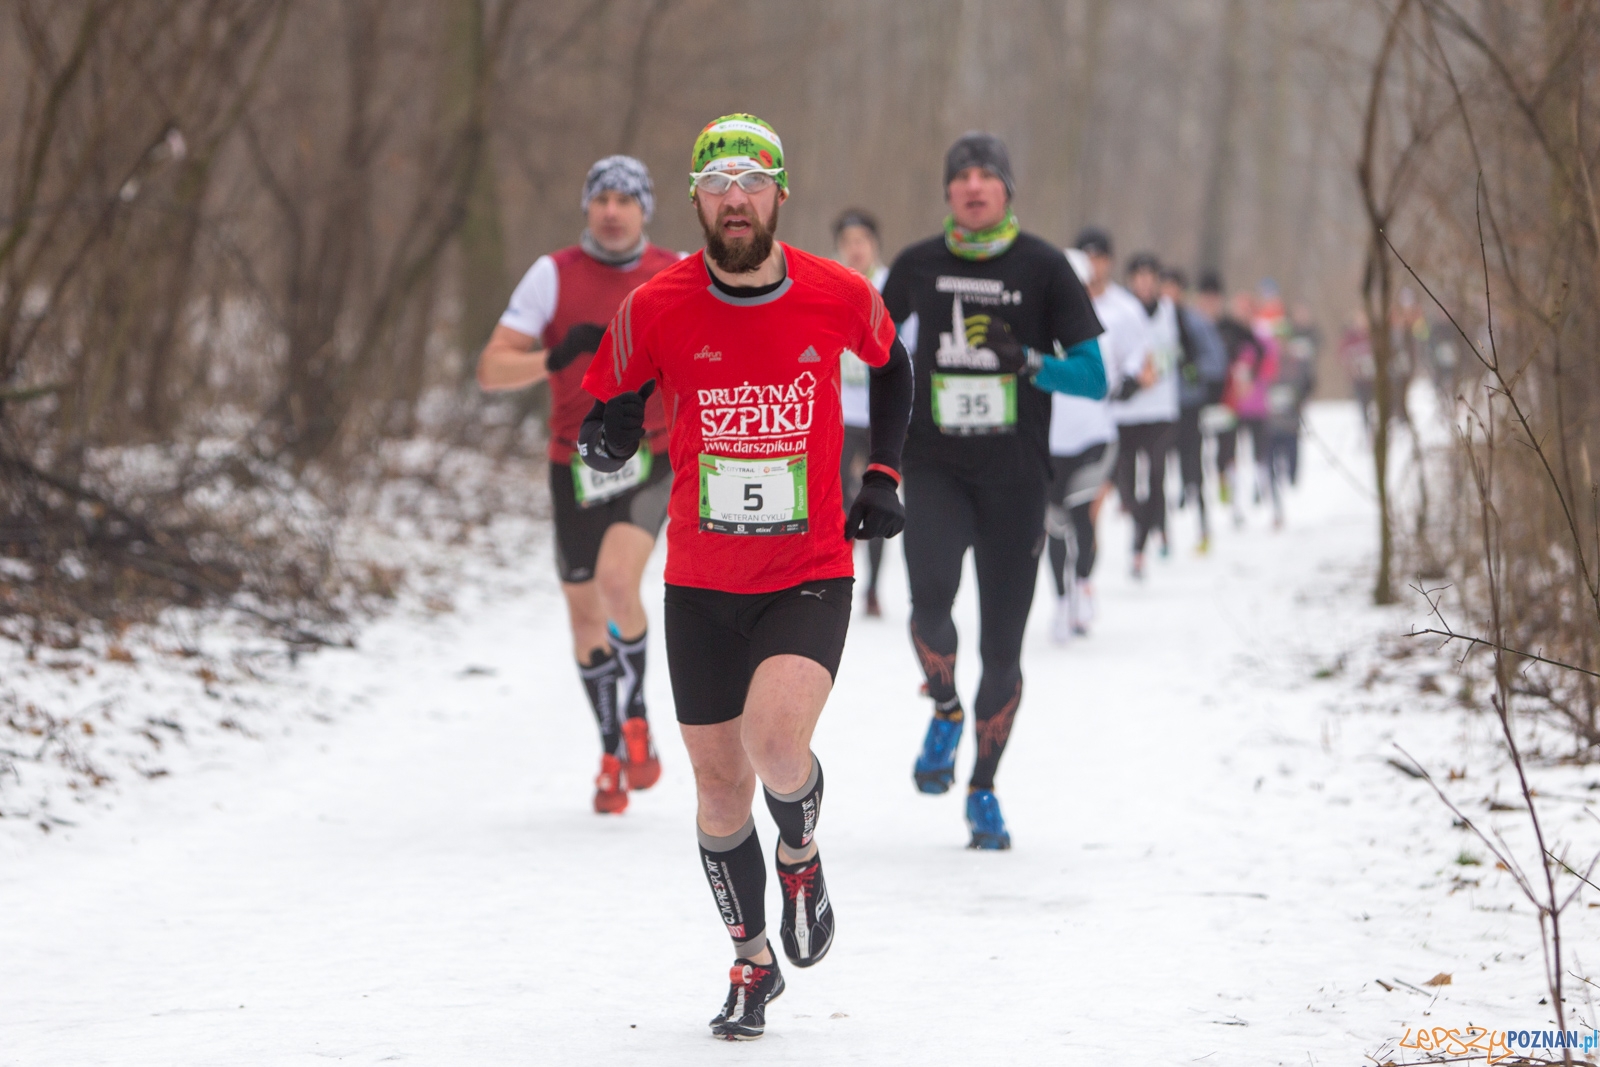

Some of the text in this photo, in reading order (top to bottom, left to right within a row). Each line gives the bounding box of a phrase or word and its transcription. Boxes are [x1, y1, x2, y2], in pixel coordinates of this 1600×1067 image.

[697, 380, 799, 406] DRUŻYNA
[956, 394, 990, 416] 35
[700, 400, 815, 437] SZPIKU
[704, 437, 807, 455] www.darszpiku.pl
[743, 483, 764, 511] 5
[721, 513, 786, 522] WETERAN CYKLU
